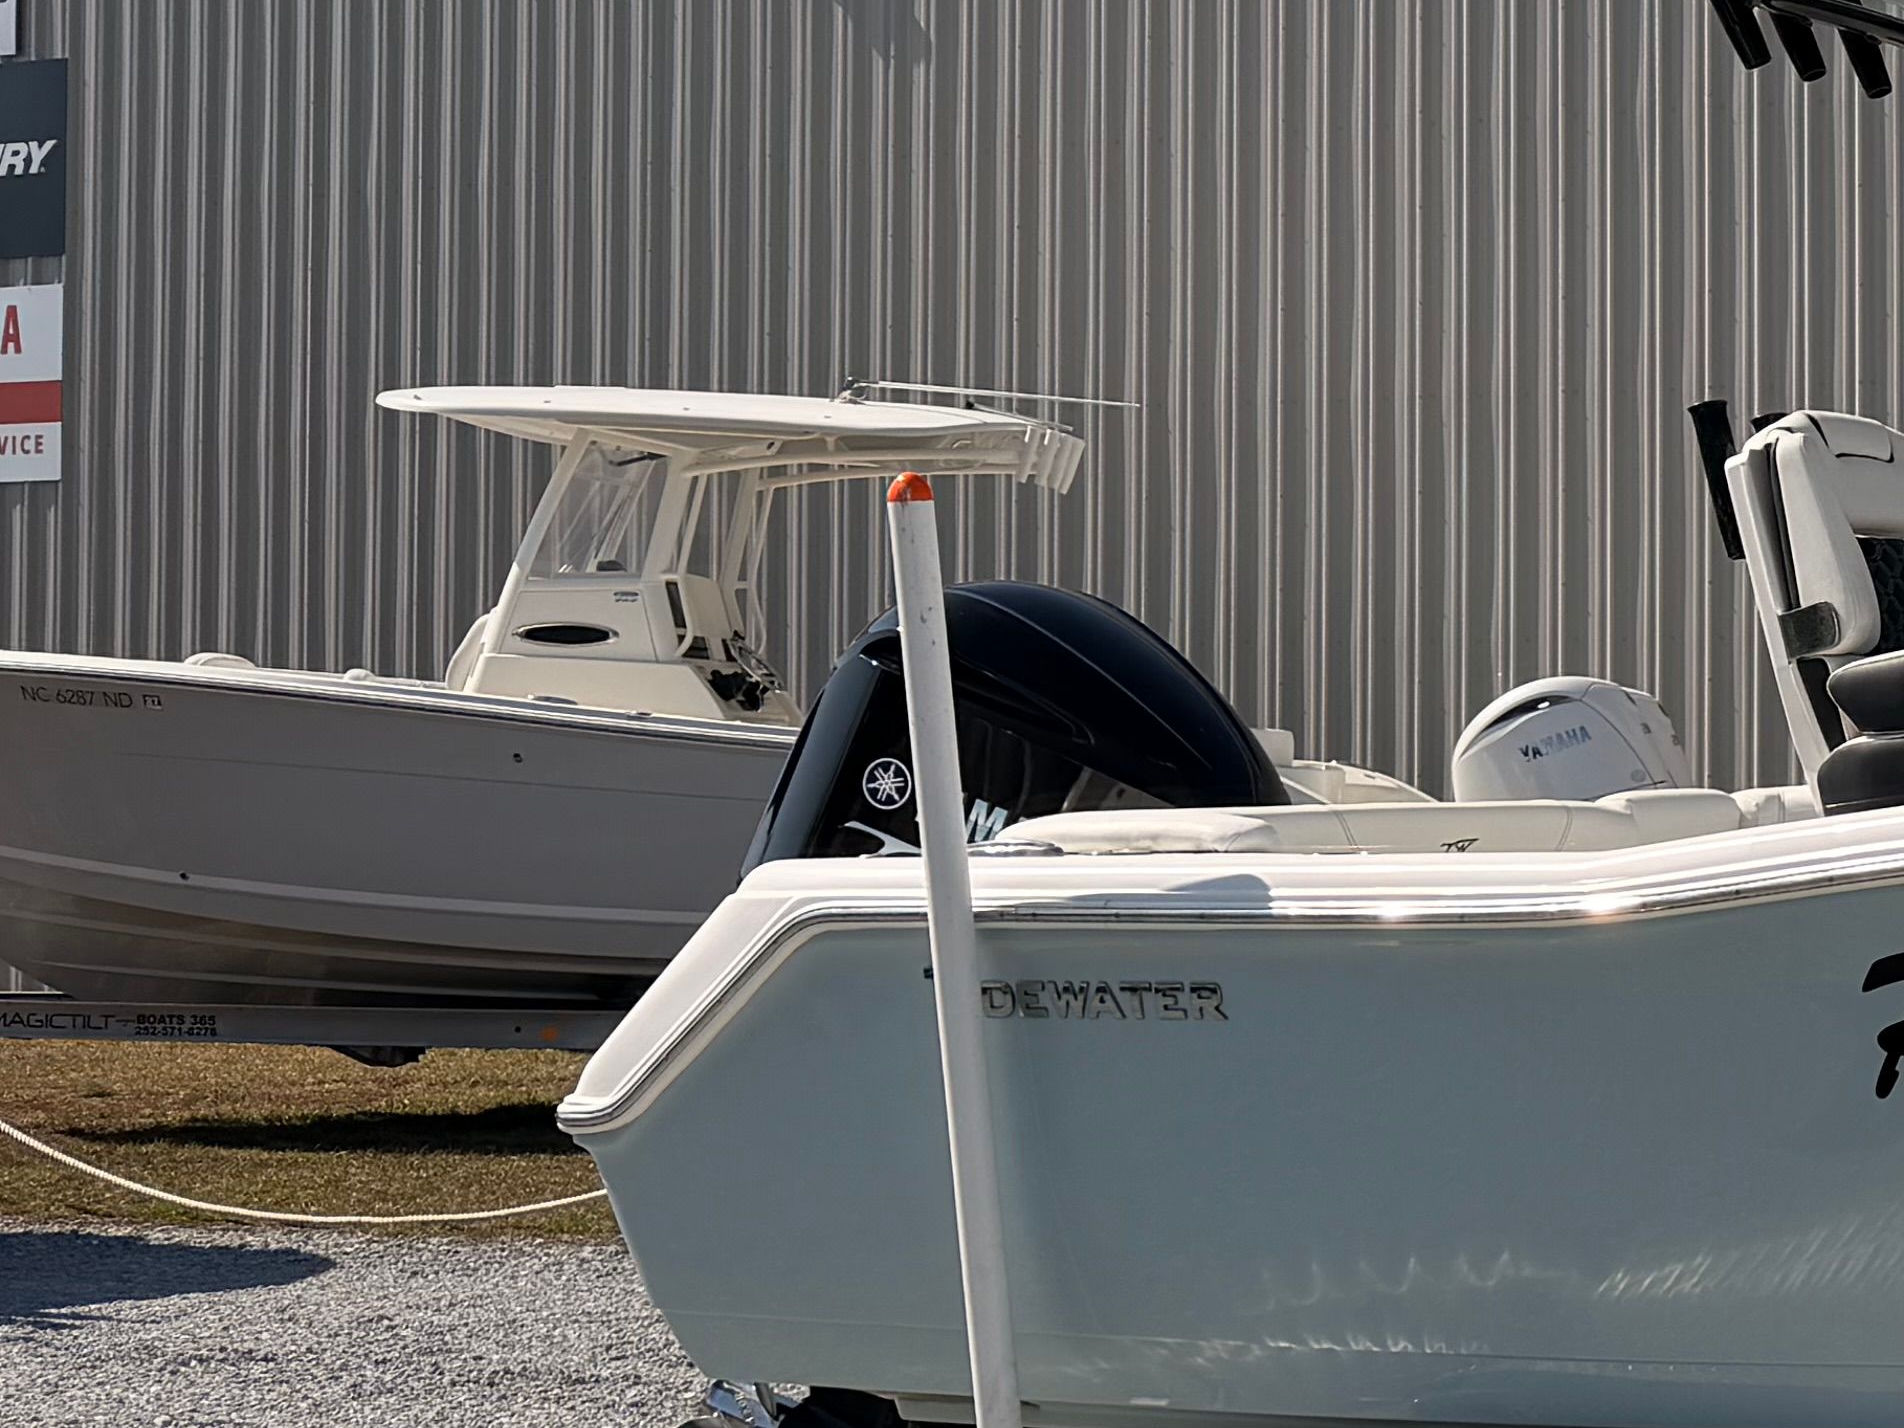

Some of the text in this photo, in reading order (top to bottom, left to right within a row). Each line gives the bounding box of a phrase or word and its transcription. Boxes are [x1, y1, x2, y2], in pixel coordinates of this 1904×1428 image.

[0, 140, 57, 176] RY
[20, 685, 50, 702] NC
[56, 689, 95, 706] 6287
[103, 691, 133, 708] ND
[980, 980, 1229, 1020] DEWATER
[136, 1014, 186, 1025] BOATS
[190, 1015, 217, 1026] 365
